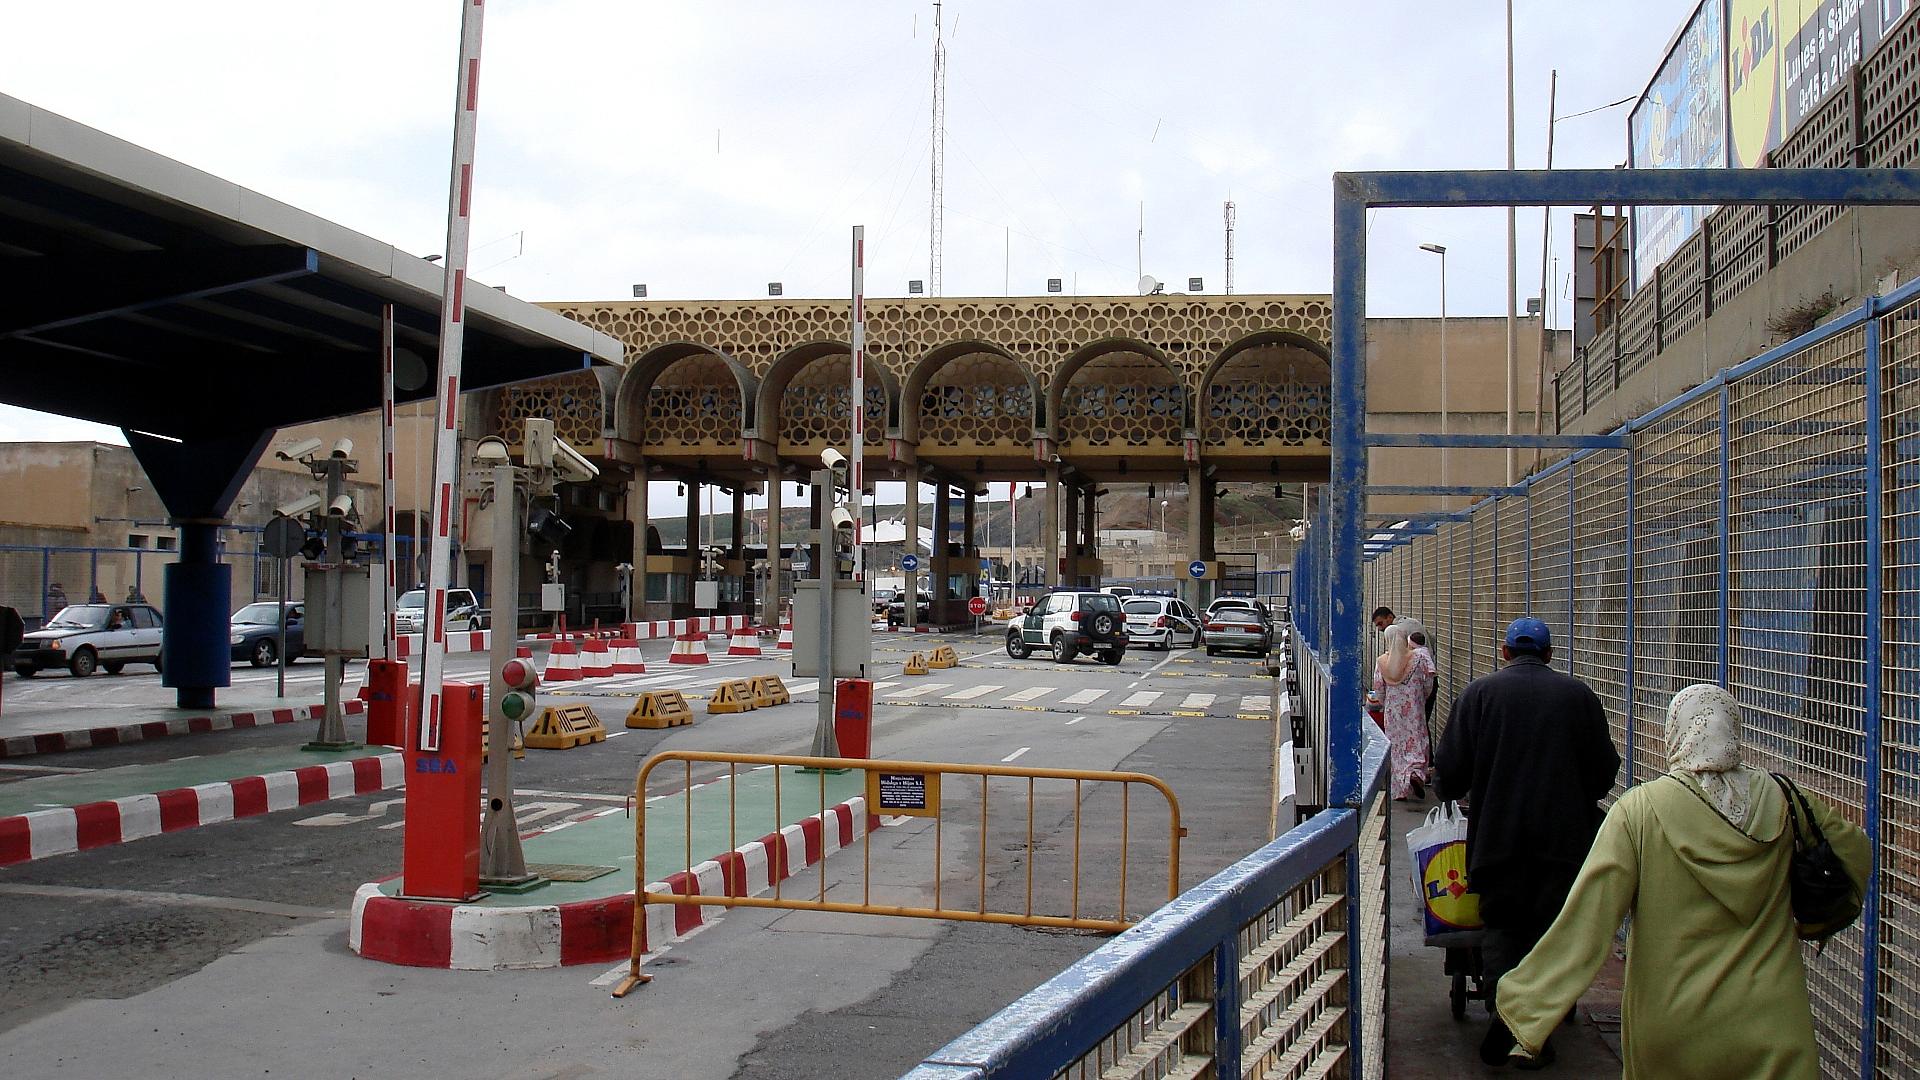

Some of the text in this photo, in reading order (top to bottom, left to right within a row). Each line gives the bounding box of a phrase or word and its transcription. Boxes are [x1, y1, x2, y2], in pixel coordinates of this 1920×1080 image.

[1785, 38, 1816, 90] Lunes
[1818, 27, 1826, 54] a
[1799, 28, 1860, 117] 9:15 a 21:15
